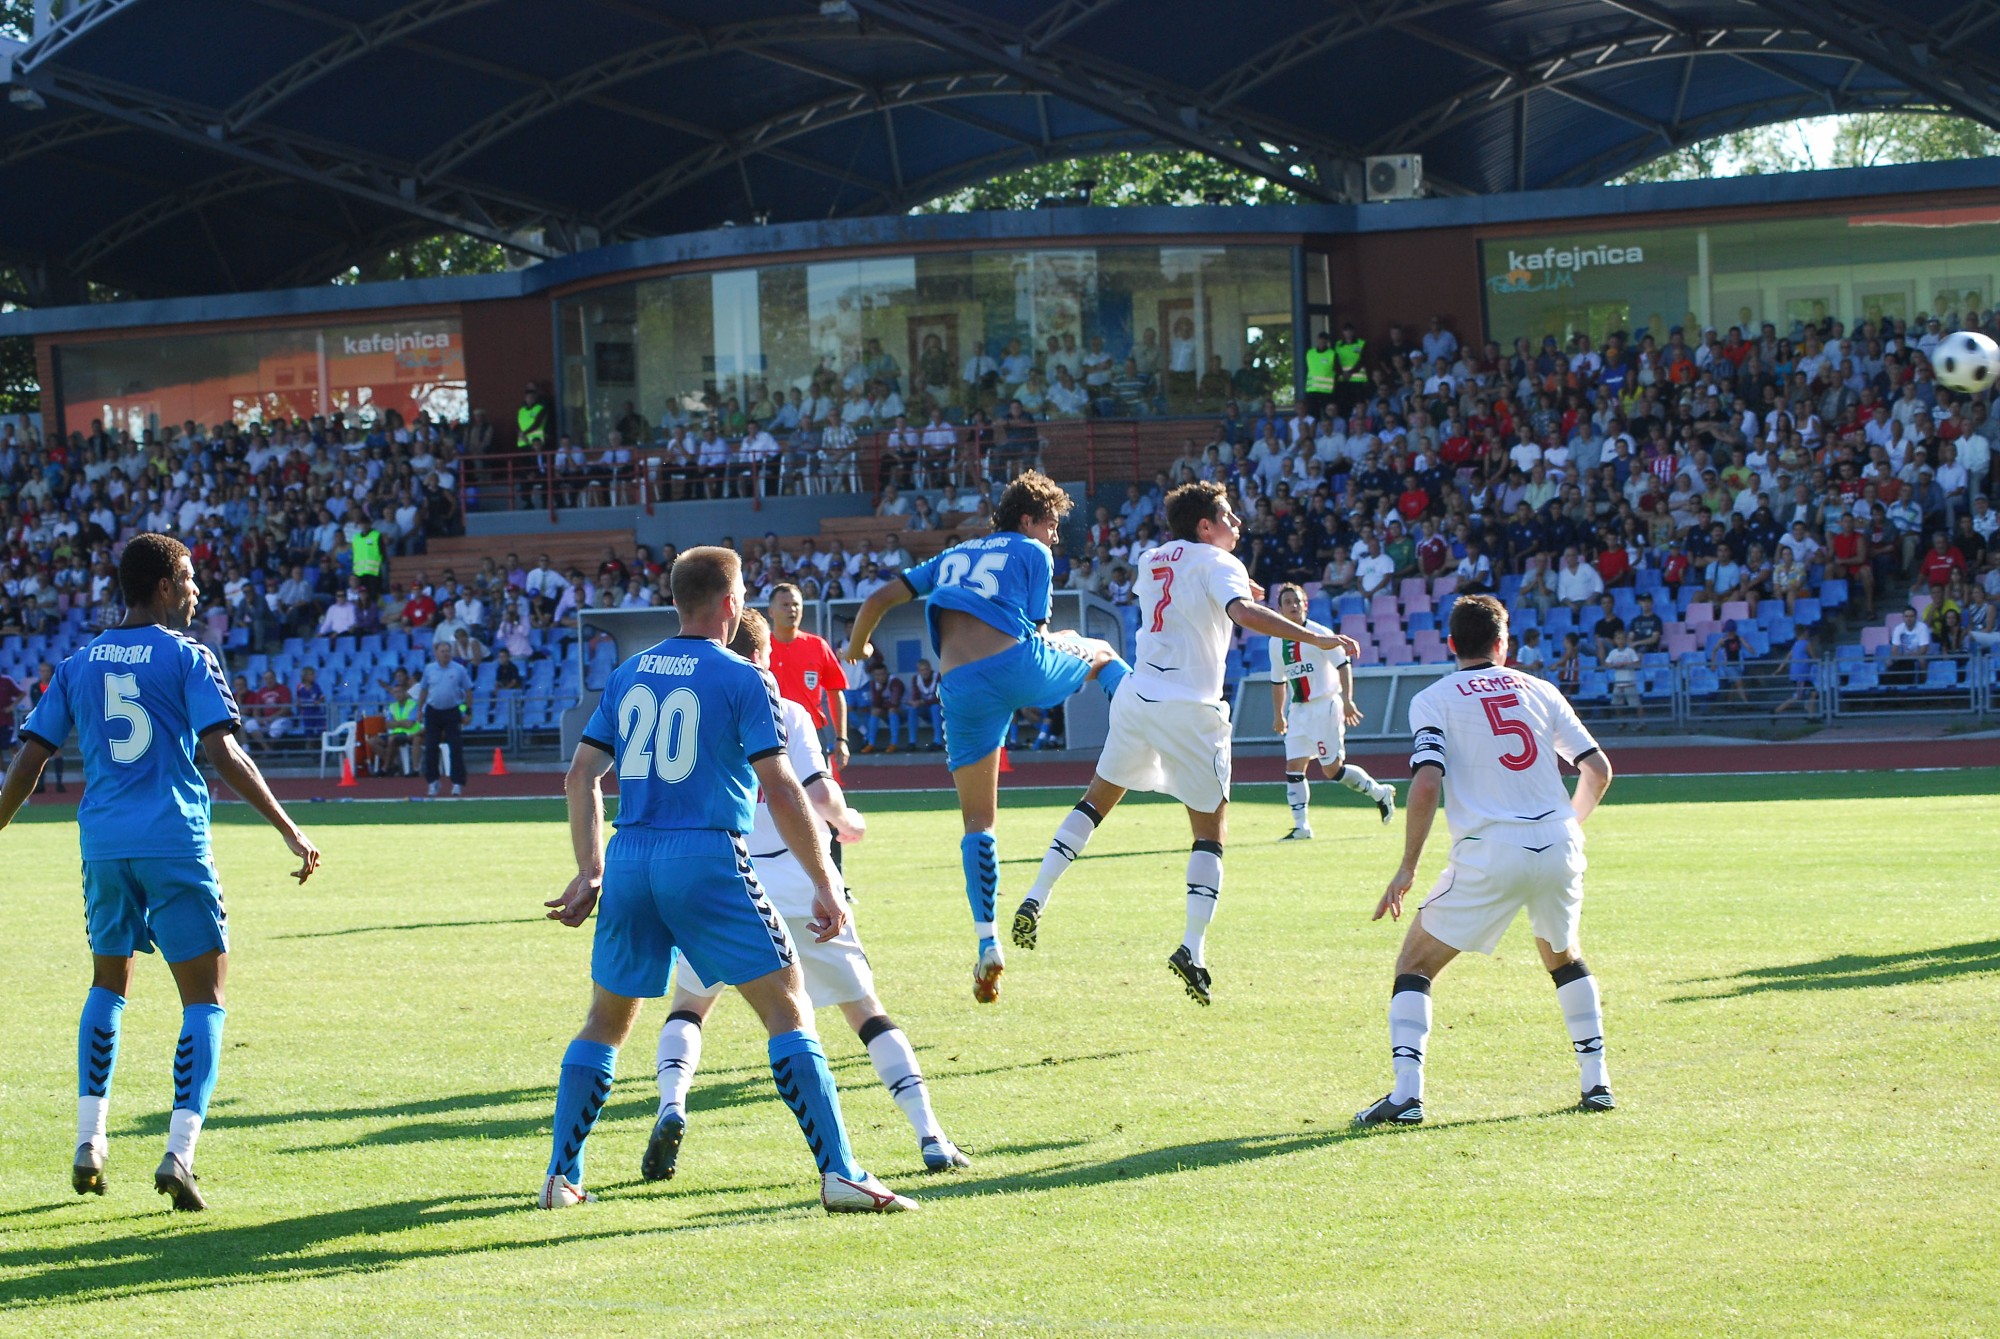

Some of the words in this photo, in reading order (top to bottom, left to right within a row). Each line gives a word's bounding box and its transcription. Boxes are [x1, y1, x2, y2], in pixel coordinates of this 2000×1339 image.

[1508, 244, 1643, 272] kafejnīca
[343, 331, 450, 355] kafejnīca
[1150, 566, 1175, 633] 7
[636, 654, 699, 676] BENIUŠIS
[104, 672, 153, 764] 5
[618, 683, 701, 784] 20
[1480, 693, 1538, 771] 5
[1317, 741, 1327, 756] 6
